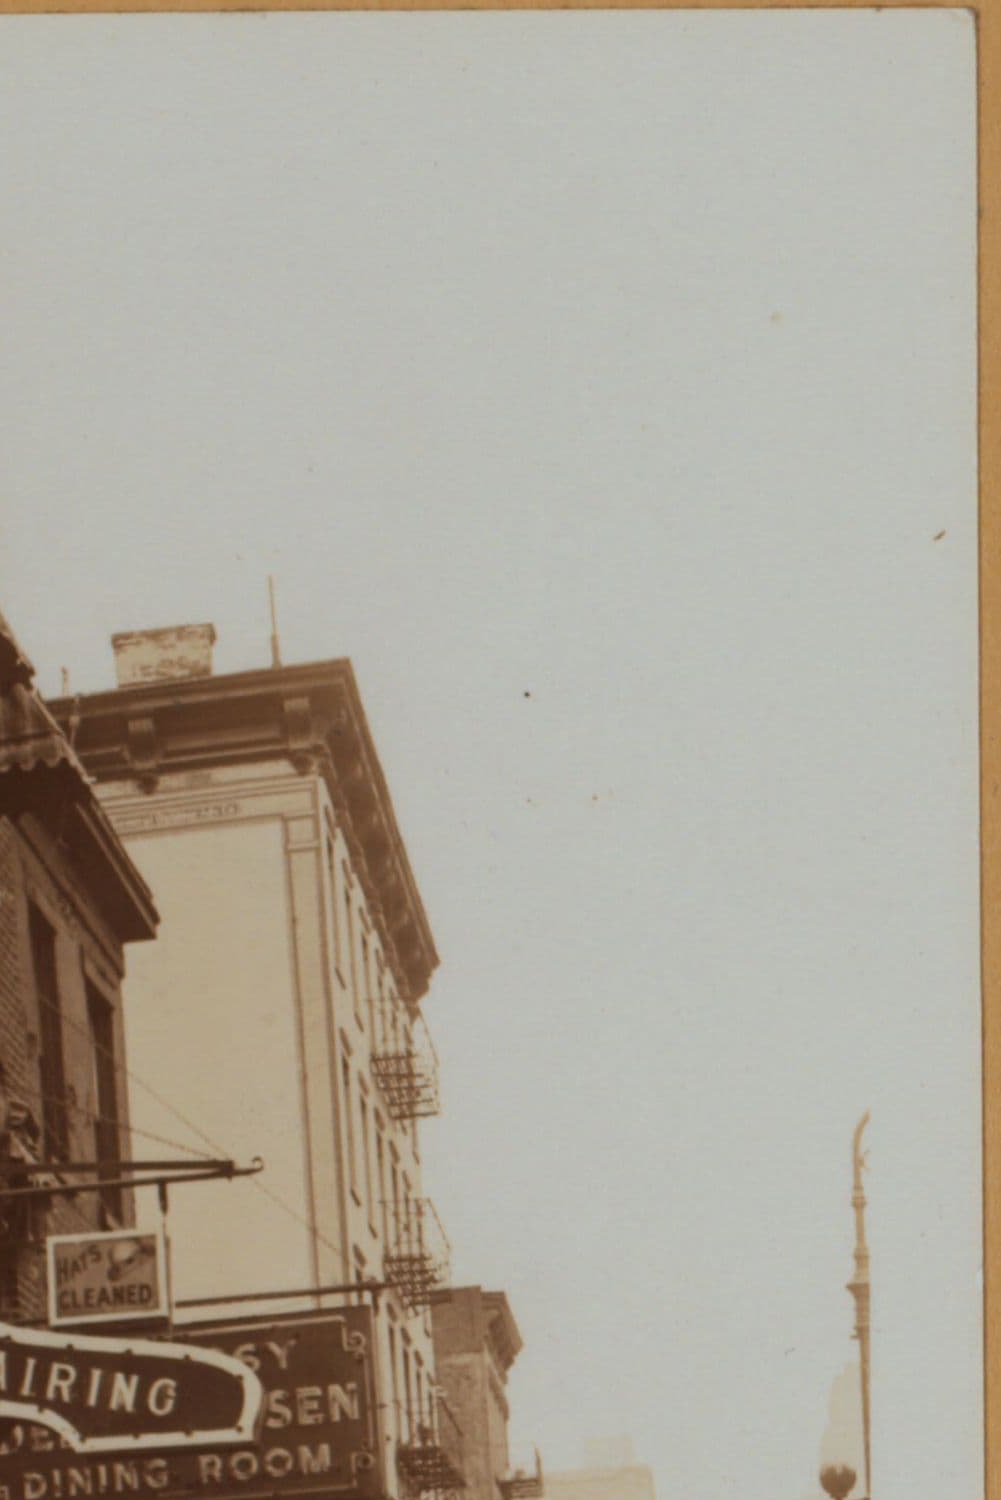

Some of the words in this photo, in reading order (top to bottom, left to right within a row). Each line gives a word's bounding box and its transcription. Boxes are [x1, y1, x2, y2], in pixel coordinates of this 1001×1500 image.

[56, 1244, 102, 1284] HATS
[58, 1283, 152, 1310] CLEANED
[200, 1441, 333, 1487] ROOM
